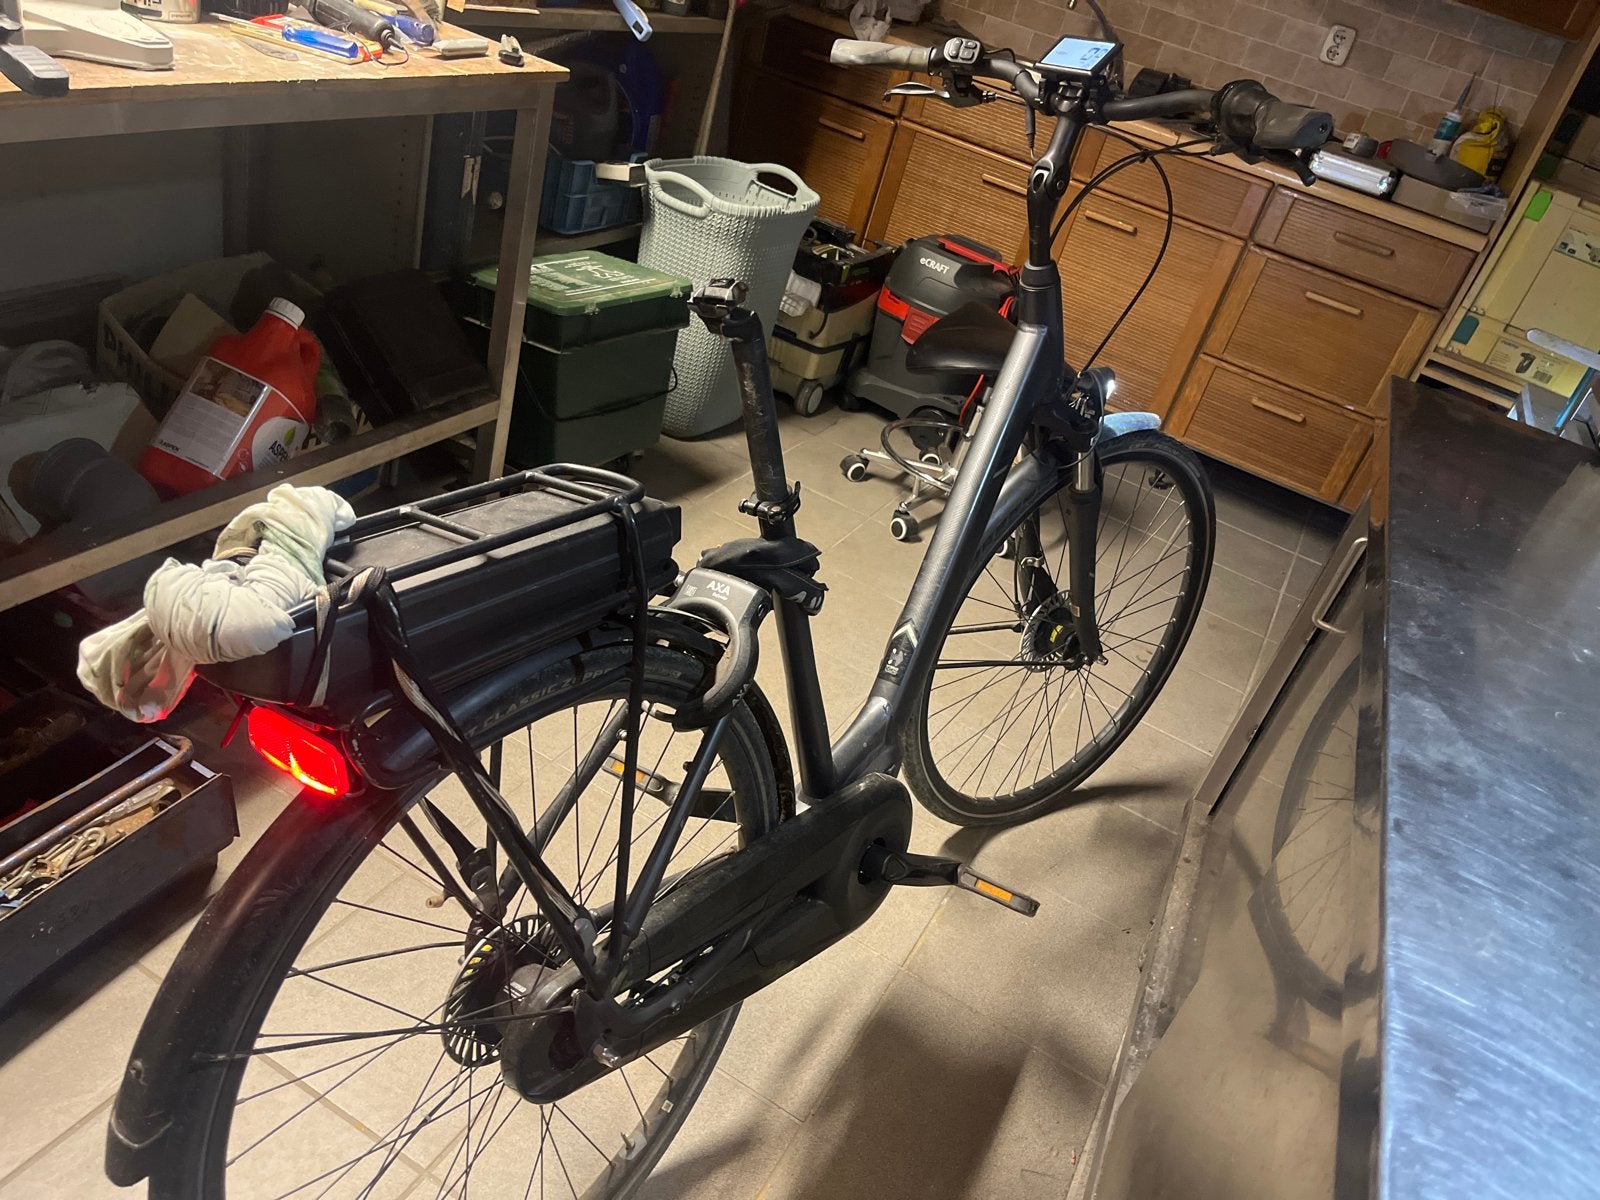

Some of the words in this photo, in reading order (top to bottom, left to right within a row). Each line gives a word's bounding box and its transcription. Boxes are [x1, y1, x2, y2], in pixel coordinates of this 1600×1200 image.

[920, 257, 949, 274] eCRAFT
[269, 440, 290, 462] ASPE
[706, 580, 731, 596] AXA
